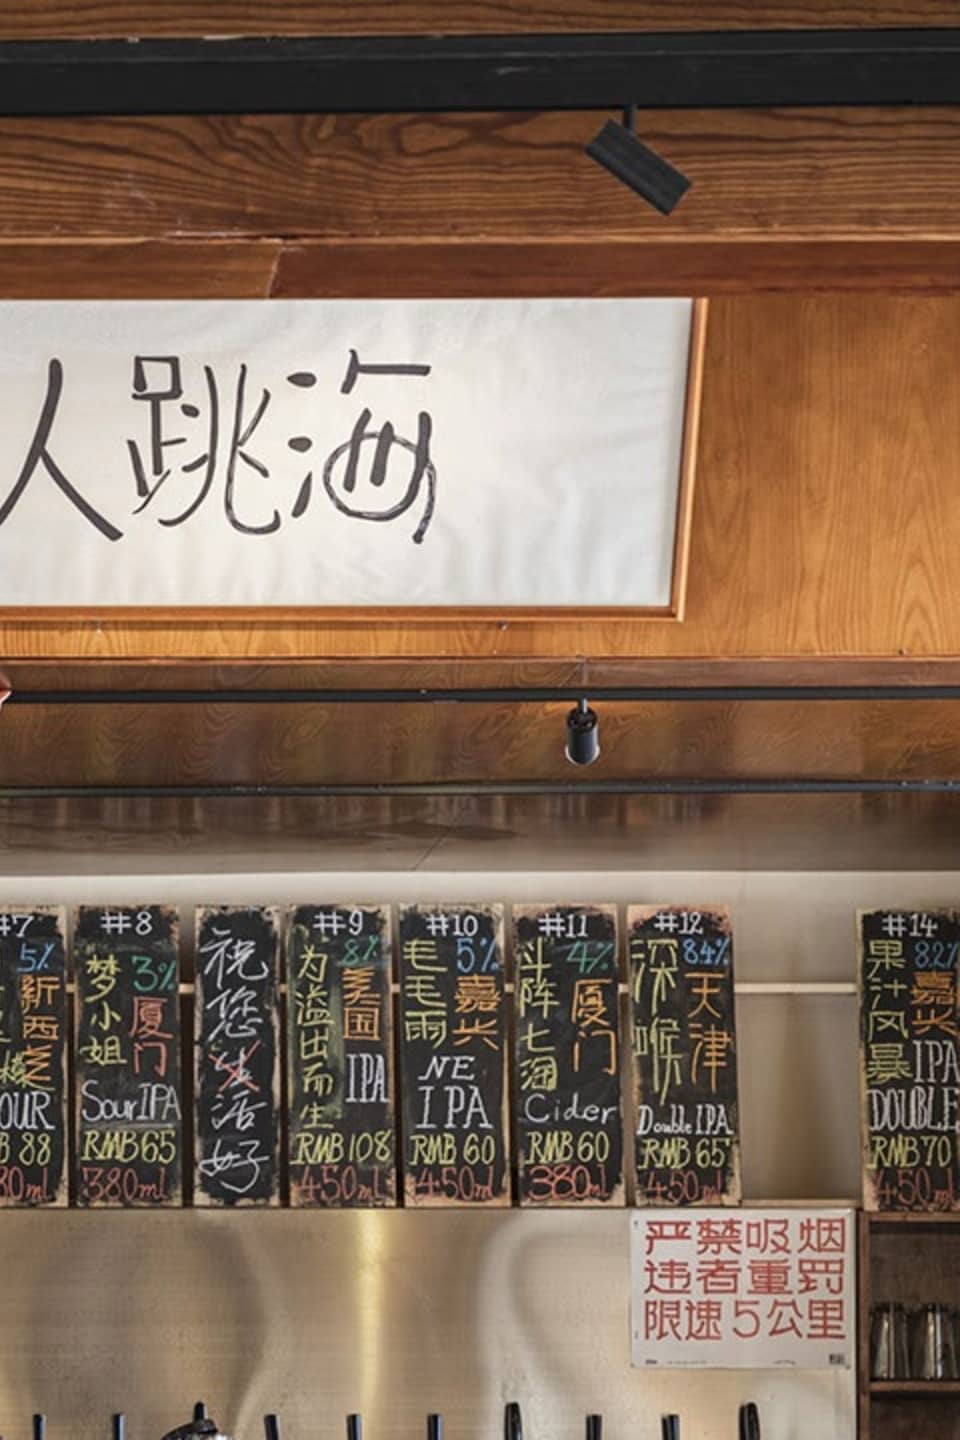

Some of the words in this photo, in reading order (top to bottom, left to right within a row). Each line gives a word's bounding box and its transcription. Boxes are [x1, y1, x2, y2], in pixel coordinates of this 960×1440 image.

[101, 911, 153, 935] #8
[313, 911, 363, 935] #9
[426, 915, 478, 938] #10
[538, 913, 588, 938] #11
[654, 911, 703, 935] #12
[882, 913, 938, 938] #14
[16, 943, 55, 973] 5%
[131, 955, 176, 992] 3%
[456, 938, 500, 973] 5%
[566, 940, 613, 973] 4%
[80, 955, 127, 1065] 梦小姐
[403, 939, 447, 1048] 毛毛雨
[571, 978, 617, 1076] 厦门
[867, 940, 913, 1085] 果汁风暴
[129, 996, 173, 1077] 厦门
[684, 972, 732, 1093] 天津
[345, 1054, 390, 1103] IPA
[418, 1056, 475, 1081] NE
[912, 1040, 960, 1083] IPA
[416, 1086, 493, 1129] IPA
[524, 1092, 617, 1123] Cider
[868, 1086, 960, 1132] DOUBLE
[644, 1217, 846, 1255] 严禁吸烟
[643, 1259, 845, 1295] 违者重罚
[644, 1299, 847, 1342] 限速5公里
